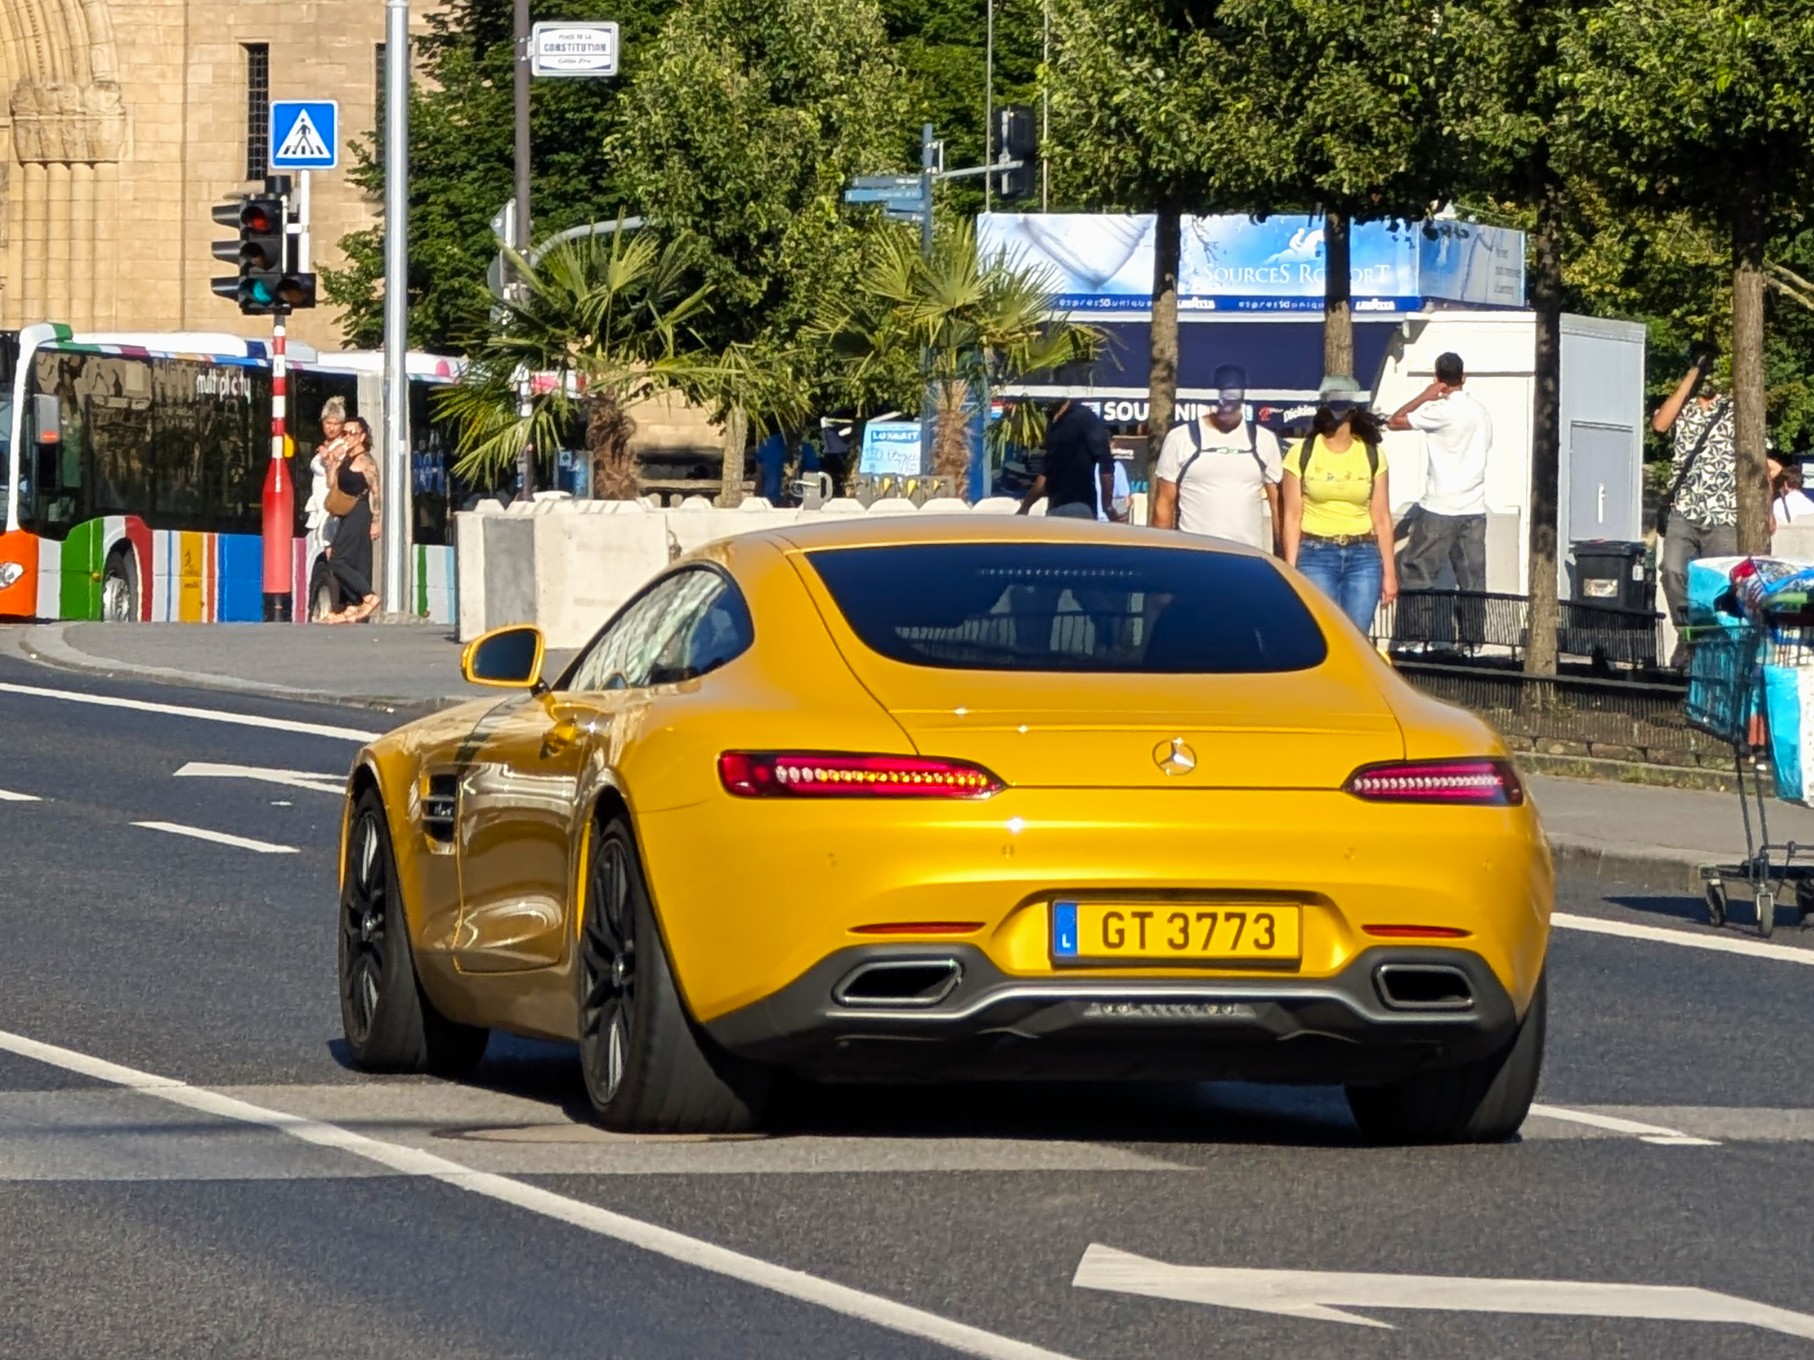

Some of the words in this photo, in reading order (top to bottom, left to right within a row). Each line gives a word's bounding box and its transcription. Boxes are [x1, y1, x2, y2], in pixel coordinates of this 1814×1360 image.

[544, 43, 606, 52] CONSTITUTION
[1102, 911, 1154, 950] GT
[1167, 912, 1275, 950] 3773
[1061, 933, 1071, 948] L
